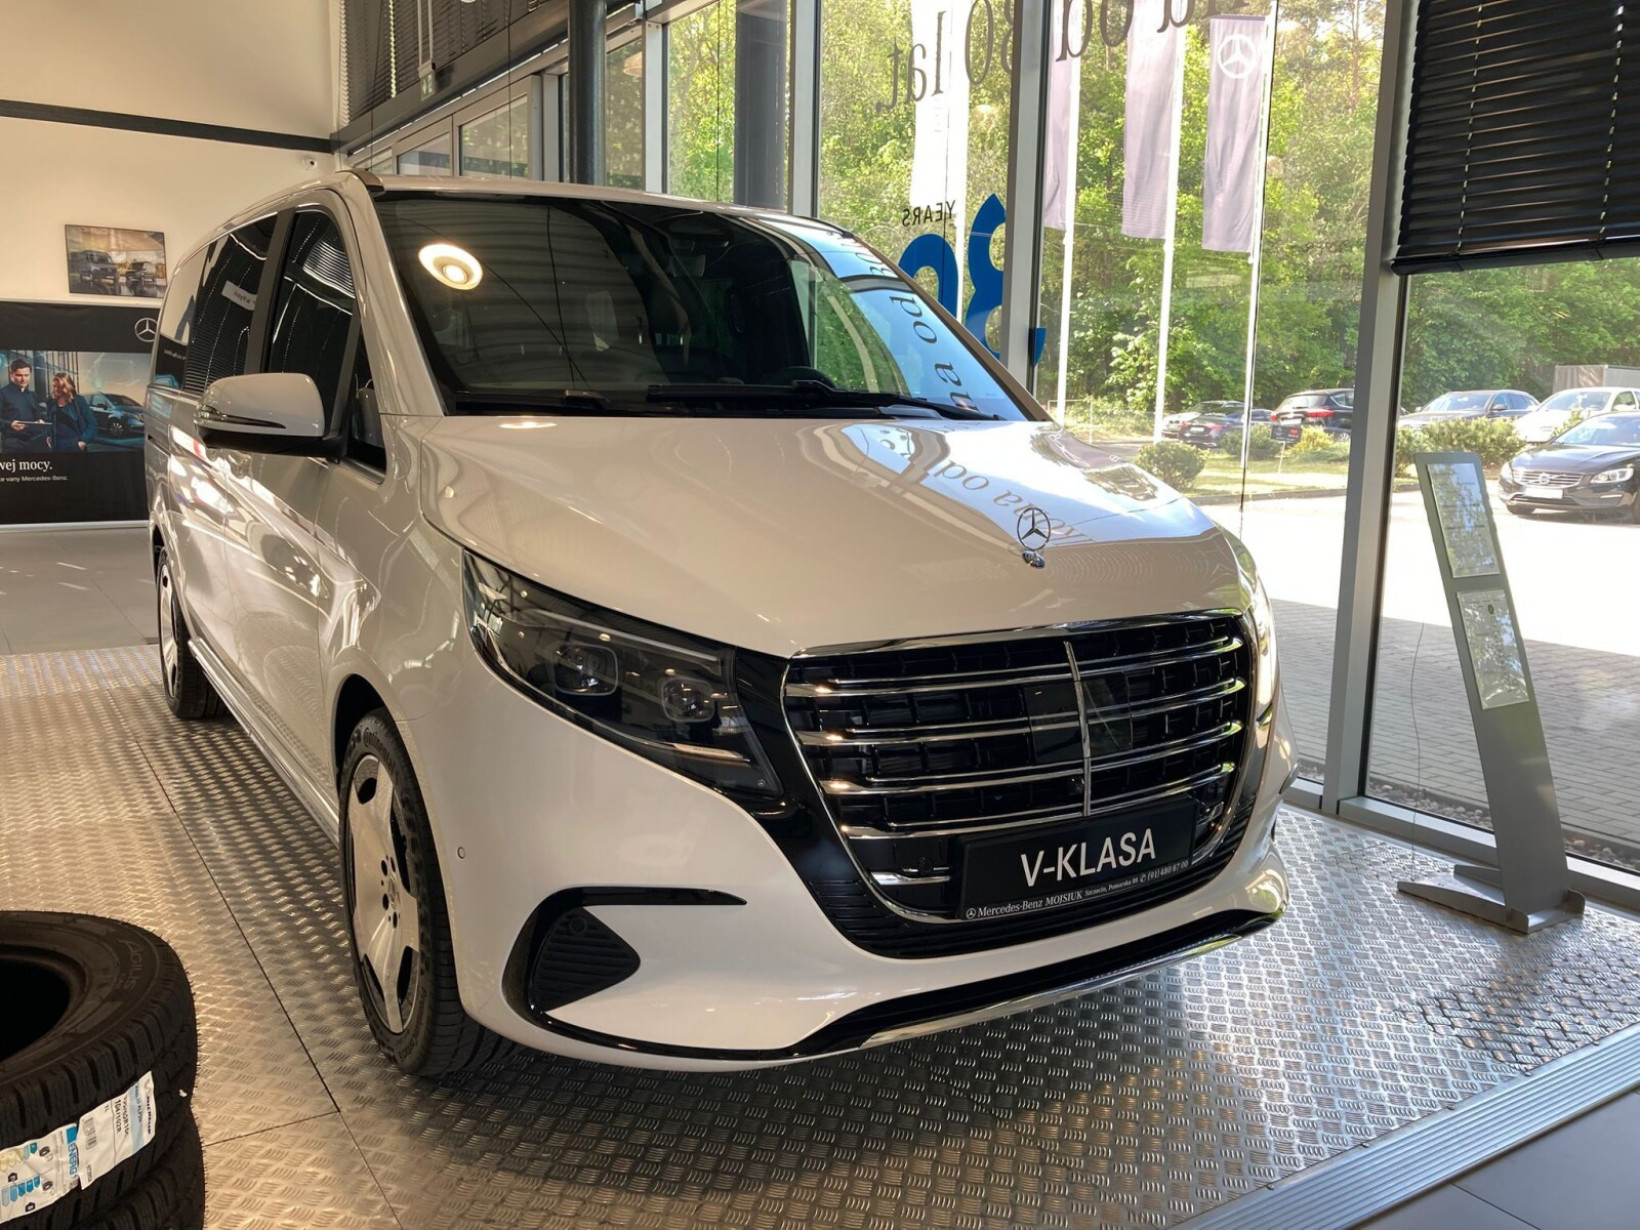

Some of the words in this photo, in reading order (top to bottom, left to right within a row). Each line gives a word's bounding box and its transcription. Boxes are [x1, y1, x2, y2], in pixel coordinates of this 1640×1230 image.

[19, 460, 53, 472] mocy.
[1020, 828, 1156, 887] V-KLASA
[977, 899, 1043, 917] Mercedes-Benz
[1045, 890, 1083, 906] MOJSIUK
[1147, 869, 1159, 879] (91)
